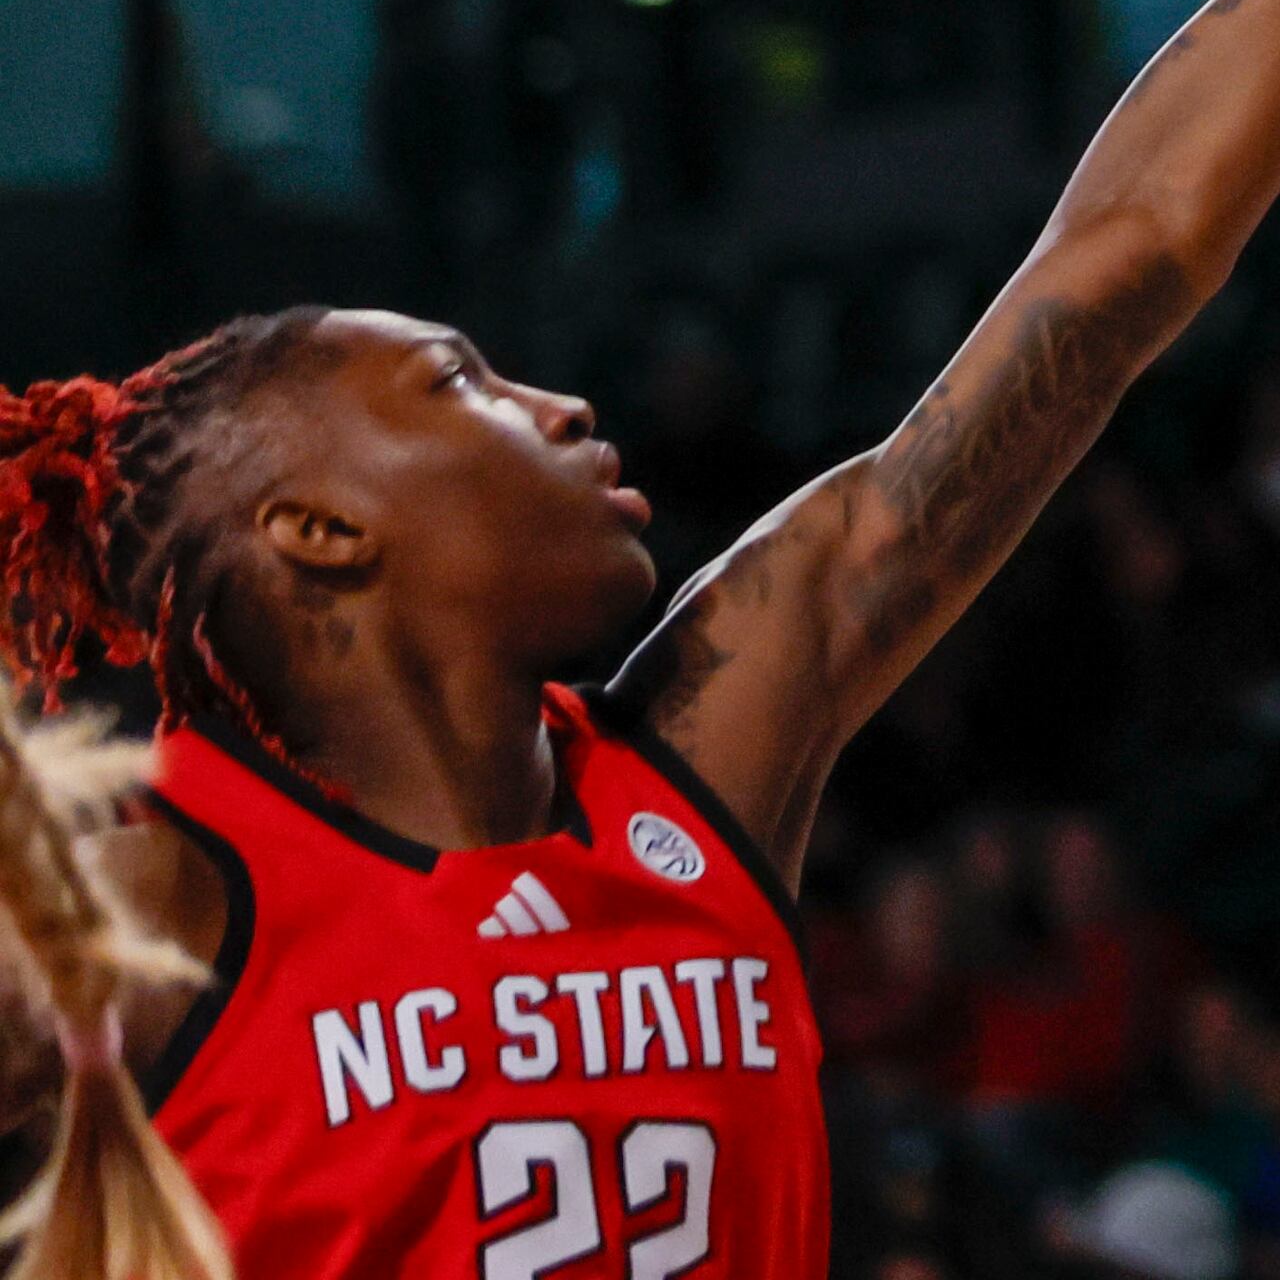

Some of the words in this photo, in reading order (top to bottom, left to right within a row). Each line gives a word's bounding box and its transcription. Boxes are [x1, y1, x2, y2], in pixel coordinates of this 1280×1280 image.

[312, 987, 467, 1128] NC
[493, 957, 777, 1083] STATE
[474, 1117, 717, 1280] 22
